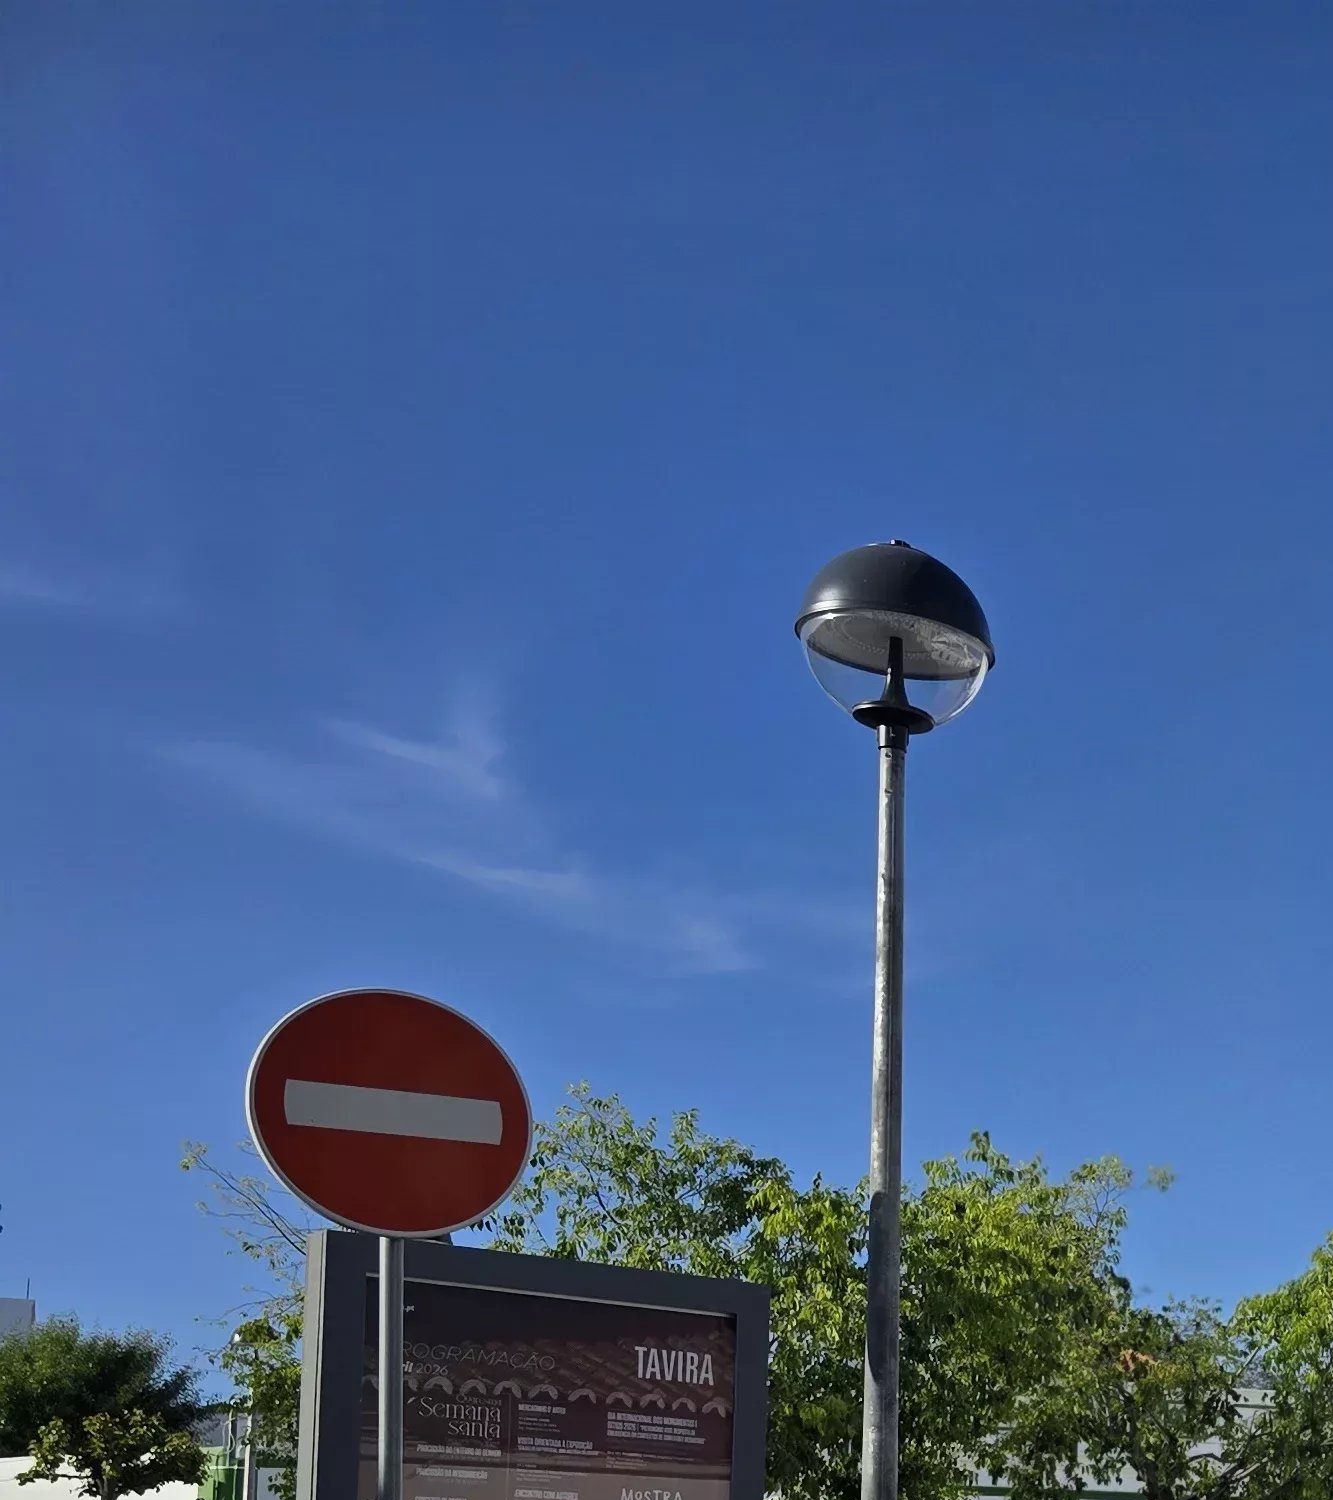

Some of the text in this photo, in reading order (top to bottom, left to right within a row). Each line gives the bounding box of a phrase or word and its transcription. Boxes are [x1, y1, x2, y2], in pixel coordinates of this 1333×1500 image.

[401, 1341, 555, 1370] ROGRAMAÇÃO
[634, 1345, 715, 1386] TAVIRA
[416, 1363, 449, 1375] 2026
[418, 1397, 501, 1422] Semana
[447, 1421, 501, 1439] santa
